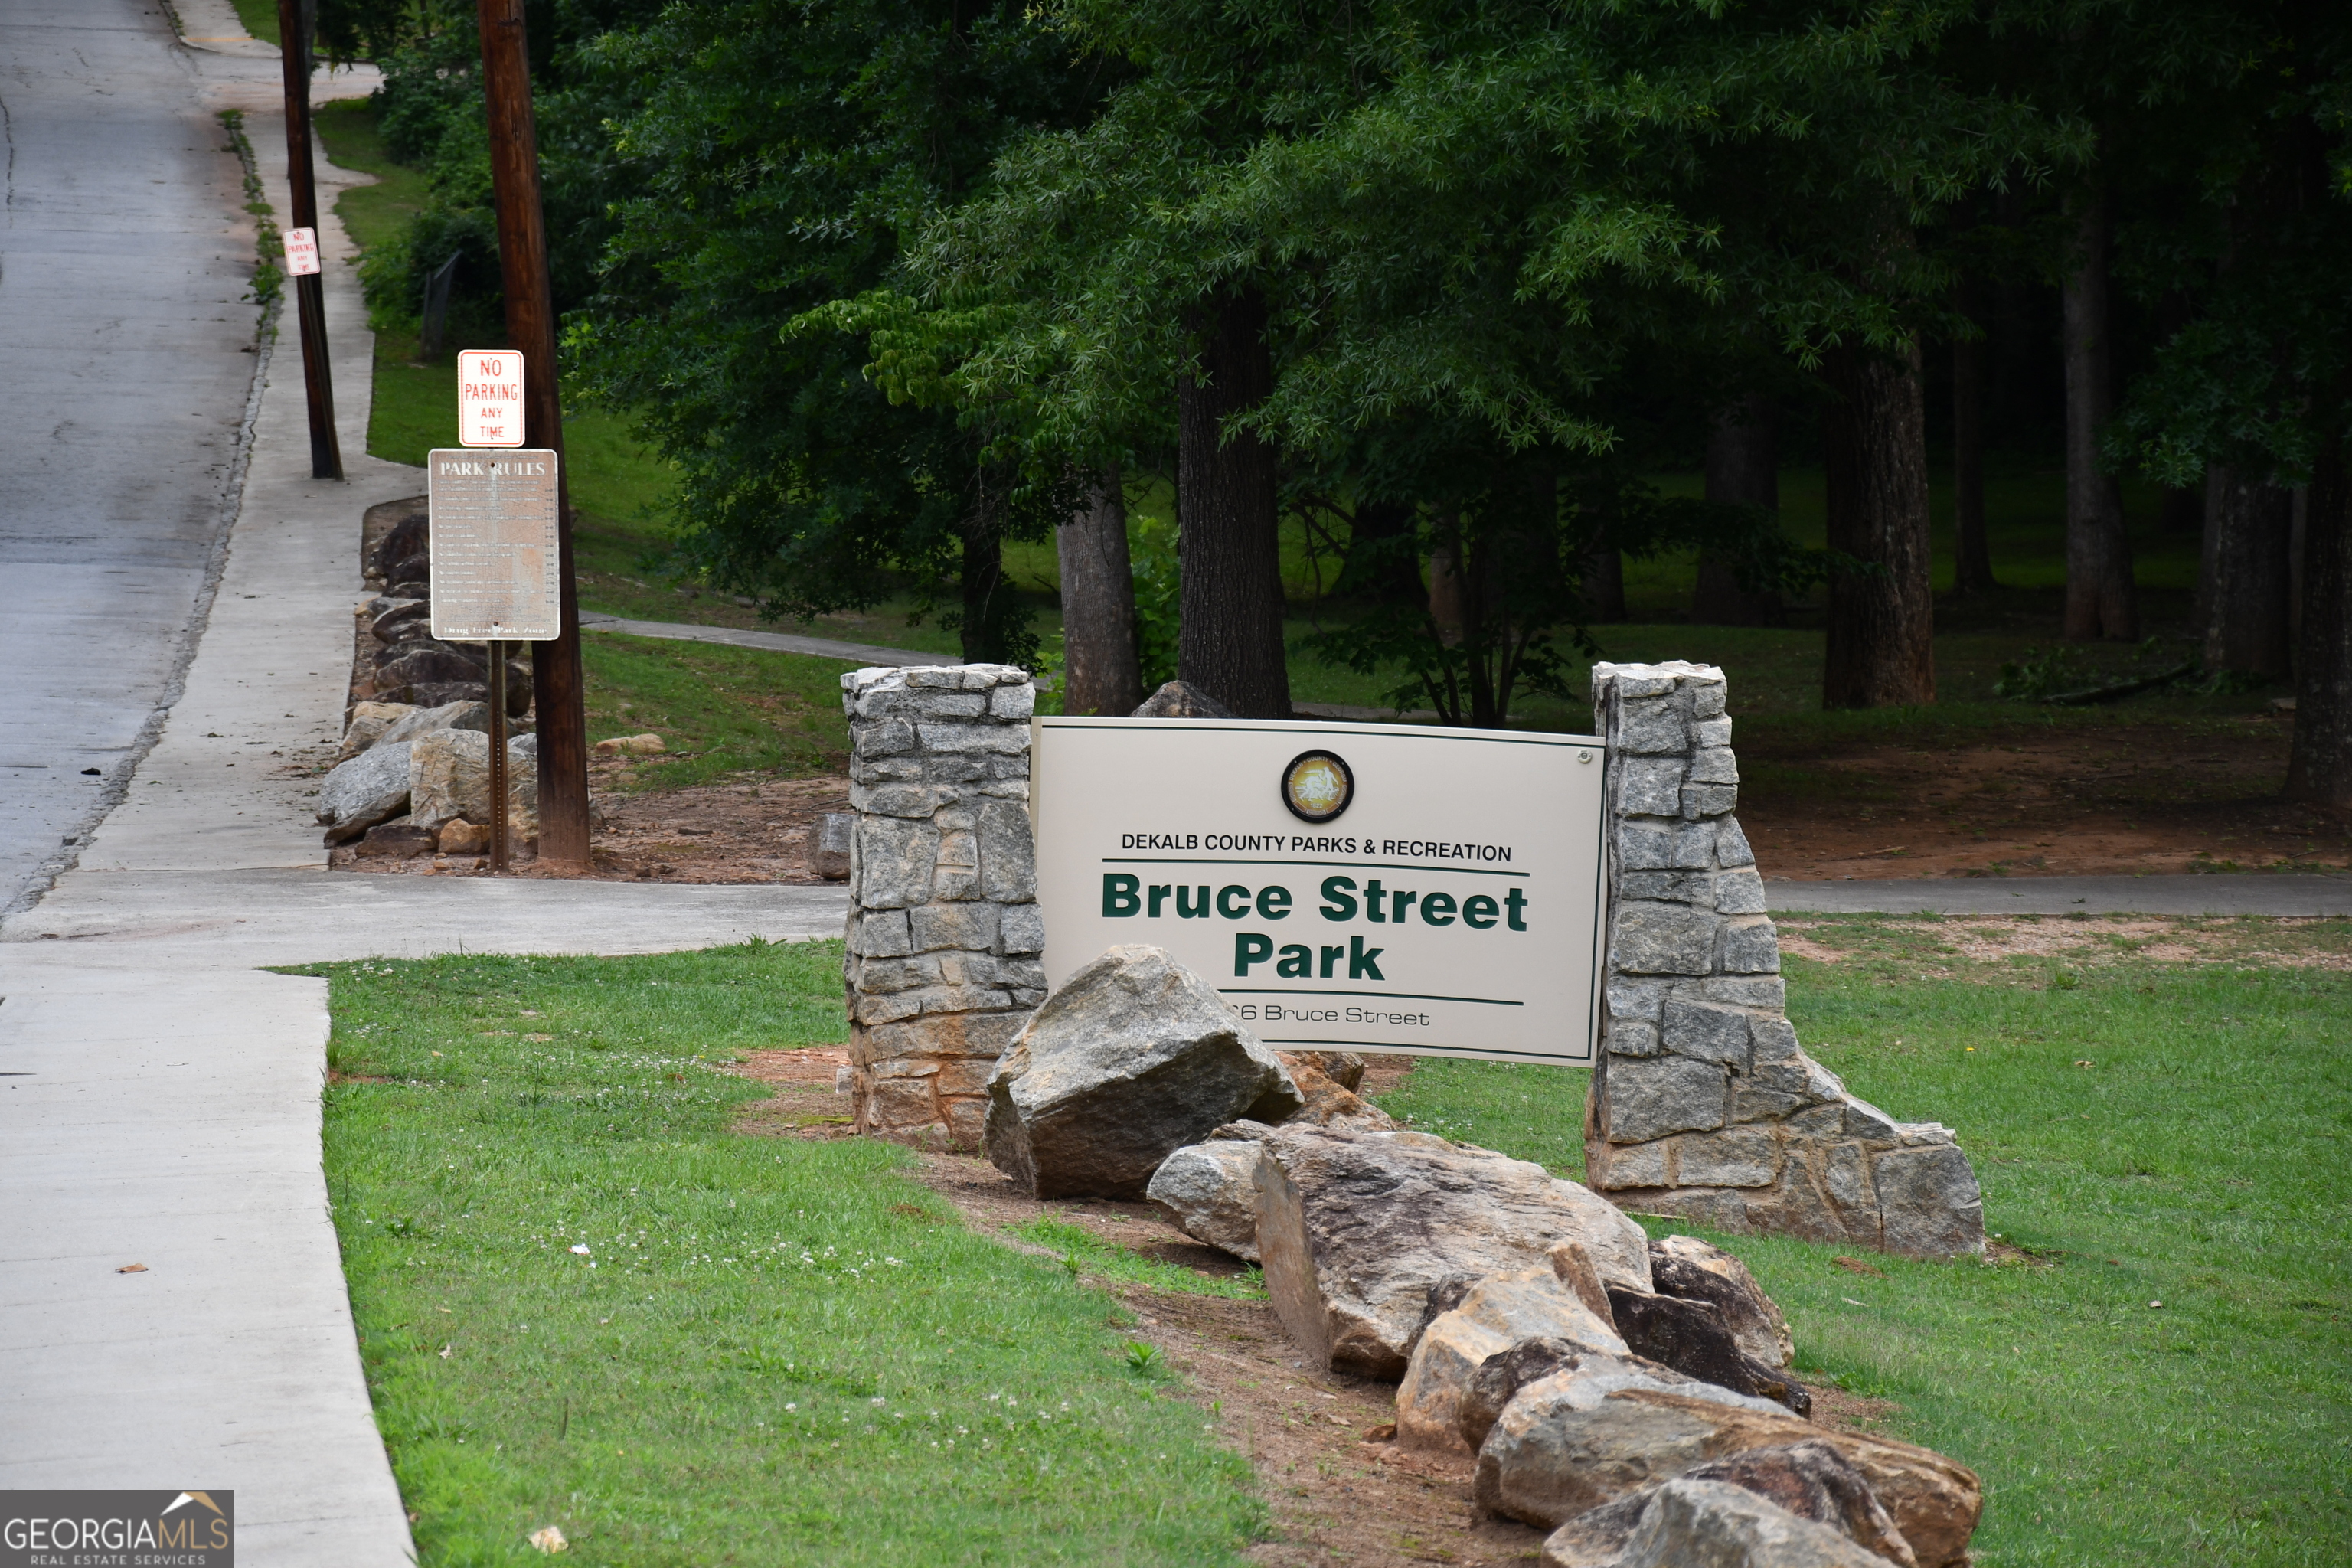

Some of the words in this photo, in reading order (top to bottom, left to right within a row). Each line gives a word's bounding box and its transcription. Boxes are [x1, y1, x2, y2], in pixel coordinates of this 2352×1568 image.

[288, 244, 314, 253] PARKING
[480, 359, 501, 377] NO
[466, 384, 518, 400] PARKING
[481, 407, 503, 419] ANY
[480, 426, 505, 438] TIME
[440, 462, 486, 476] PARK
[493, 462, 546, 476] RULES
[444, 626, 469, 635] Drug
[1289, 762, 1304, 781] DEKALB
[1332, 762, 1348, 783] GEORGIA
[1122, 833, 1199, 850] DEKALB
[1205, 834, 1286, 851] COUNTY
[1292, 836, 1357, 854] PARKS
[1364, 839, 1376, 854] &
[1383, 840, 1511, 862] RECREATION
[1102, 874, 1293, 920] Bruce
[1319, 876, 1529, 933] Street
[1234, 933, 1386, 982] Park
[1232, 1004, 1257, 1021] 6
[1265, 1004, 1338, 1021] Bruce
[1345, 1007, 1430, 1027] Street
